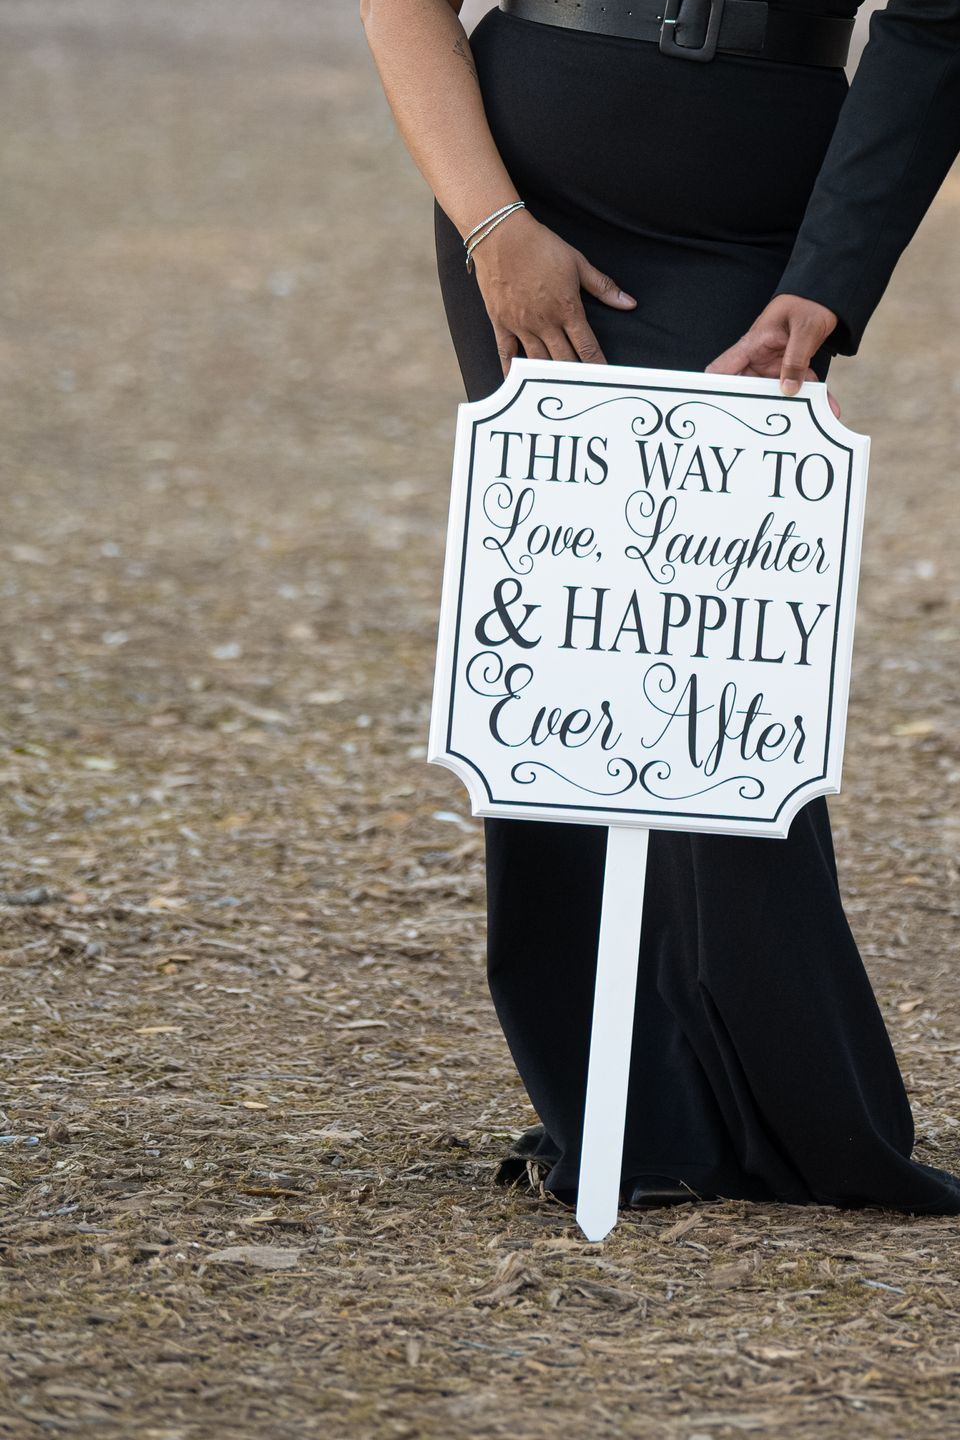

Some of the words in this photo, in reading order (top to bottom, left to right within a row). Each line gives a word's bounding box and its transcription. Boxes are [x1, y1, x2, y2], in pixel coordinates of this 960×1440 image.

[490, 430, 609, 486] THIS
[635, 440, 746, 494] WAY
[762, 450, 835, 502] TO
[482, 482, 603, 575] Love,
[624, 490, 830, 591] Laughter
[474, 578, 542, 649] &
[557, 585, 831, 666] HAPPILY
[465, 651, 622, 751] Ever
[640, 662, 807, 777] After
